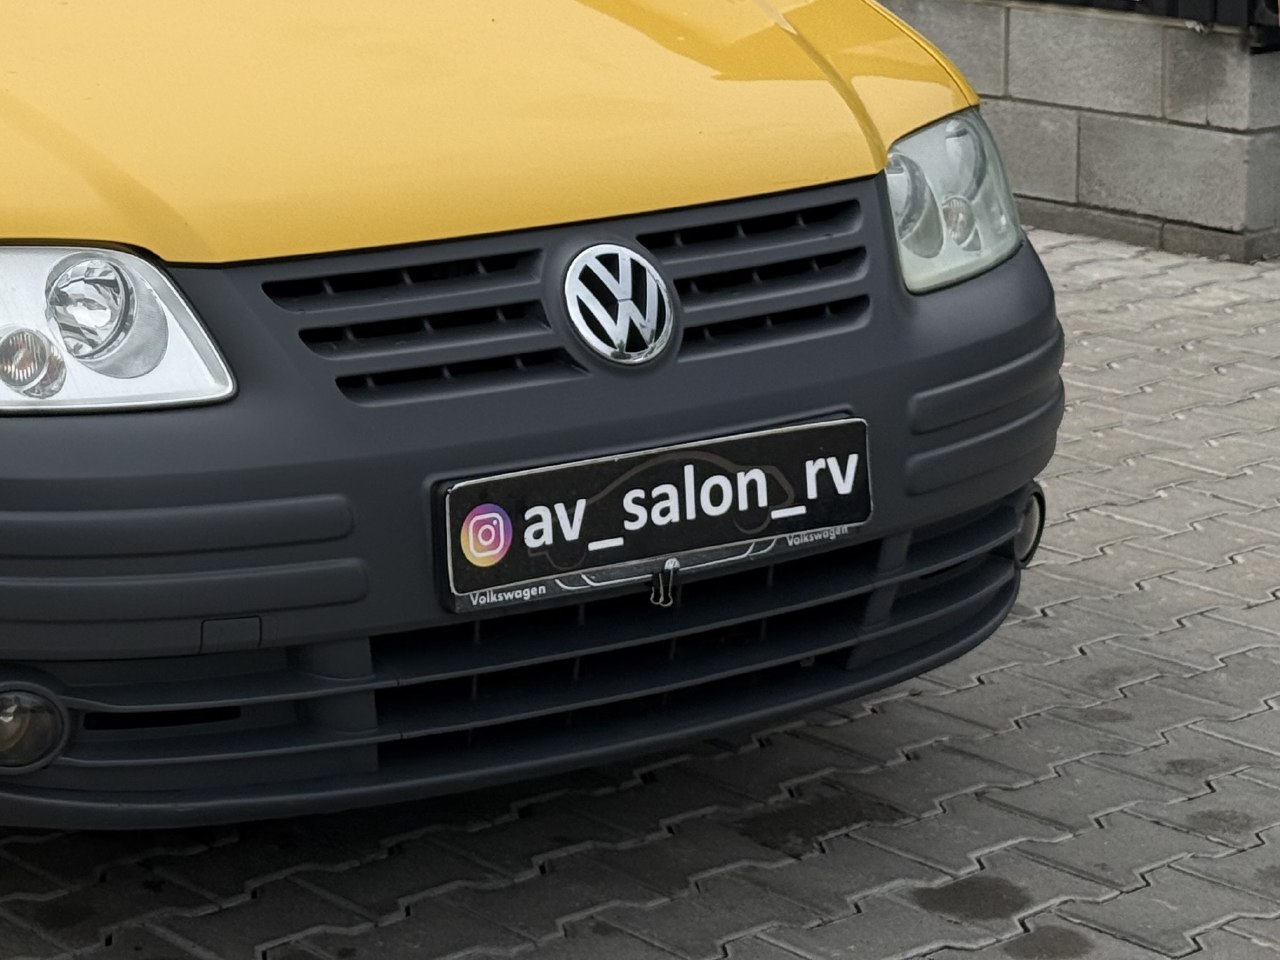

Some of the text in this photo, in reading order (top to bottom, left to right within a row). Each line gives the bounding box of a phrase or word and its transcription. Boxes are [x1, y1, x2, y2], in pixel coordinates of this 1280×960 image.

[524, 453, 858, 552] av_salon_rv
[785, 524, 849, 548] Volkswagen
[469, 584, 547, 607] Volkswagen
